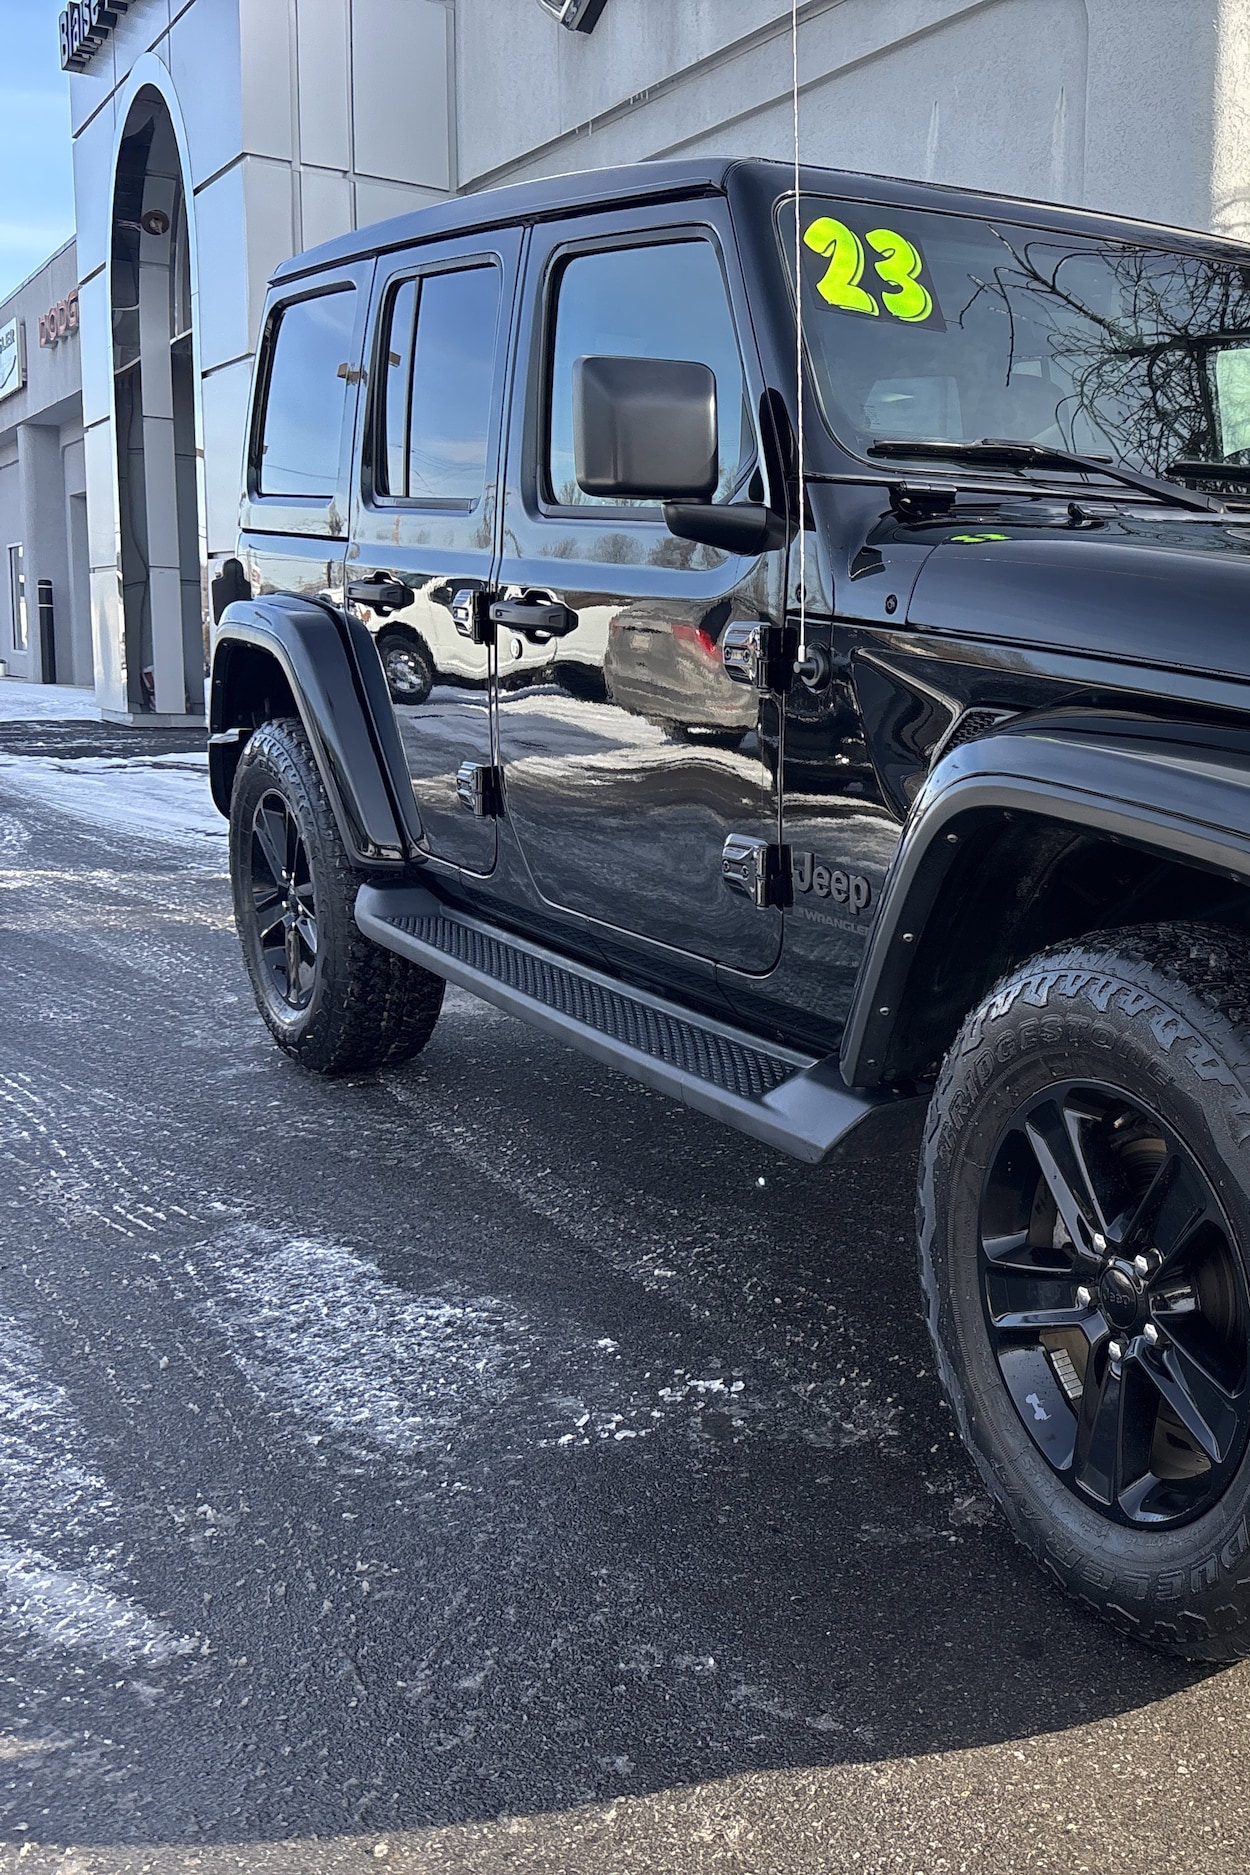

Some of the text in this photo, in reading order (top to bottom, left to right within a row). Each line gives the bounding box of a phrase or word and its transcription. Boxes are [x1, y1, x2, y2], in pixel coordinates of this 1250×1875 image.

[803, 216, 933, 322] 23
[39, 288, 79, 348] DODG
[793, 851, 871, 915] Jeep
[938, 1013, 1176, 1160] BRIDGESTONE
[1044, 1514, 1250, 1600] DUELER
